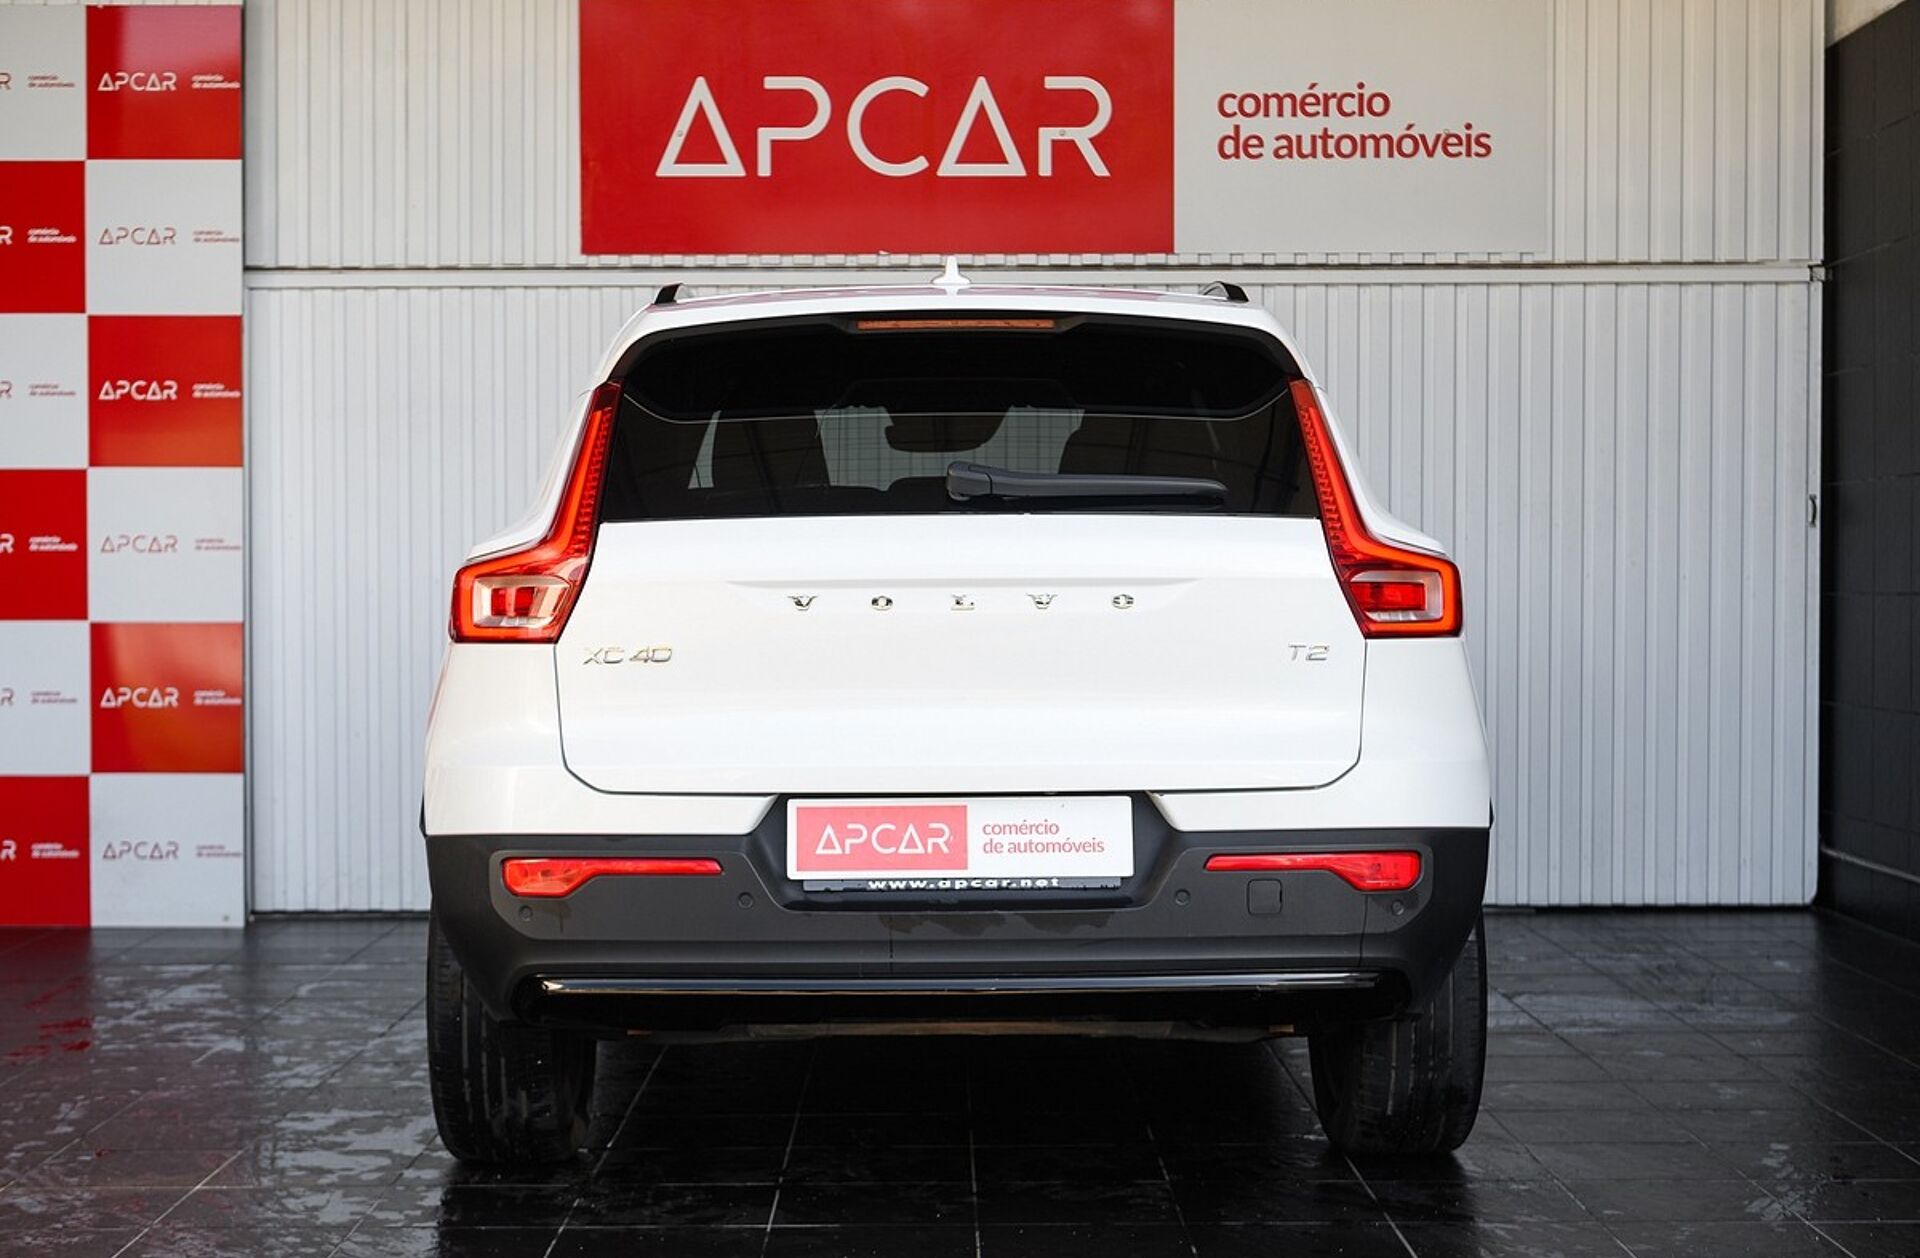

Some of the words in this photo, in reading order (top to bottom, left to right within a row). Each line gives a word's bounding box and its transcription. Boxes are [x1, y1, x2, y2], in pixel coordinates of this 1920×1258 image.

[97, 71, 178, 92] APCAR
[1218, 82, 1391, 118] comércio
[656, 75, 1112, 178] APCAR
[1218, 128, 1264, 160] de
[1274, 123, 1493, 160] automóveis
[98, 226, 177, 246] APCAR
[98, 379, 178, 401] APCAR
[100, 534, 178, 554] APCAR
[787, 594, 1136, 612] VOLVO
[1287, 644, 1330, 662] T2
[99, 685, 179, 708] APCAR
[983, 819, 1059, 835] comércio
[815, 823, 951, 855] APCAR
[983, 837, 1004, 853] de
[1008, 834, 1105, 853] automóveis
[102, 841, 179, 861] APCAR
[867, 878, 1060, 890] www.apcar.net
